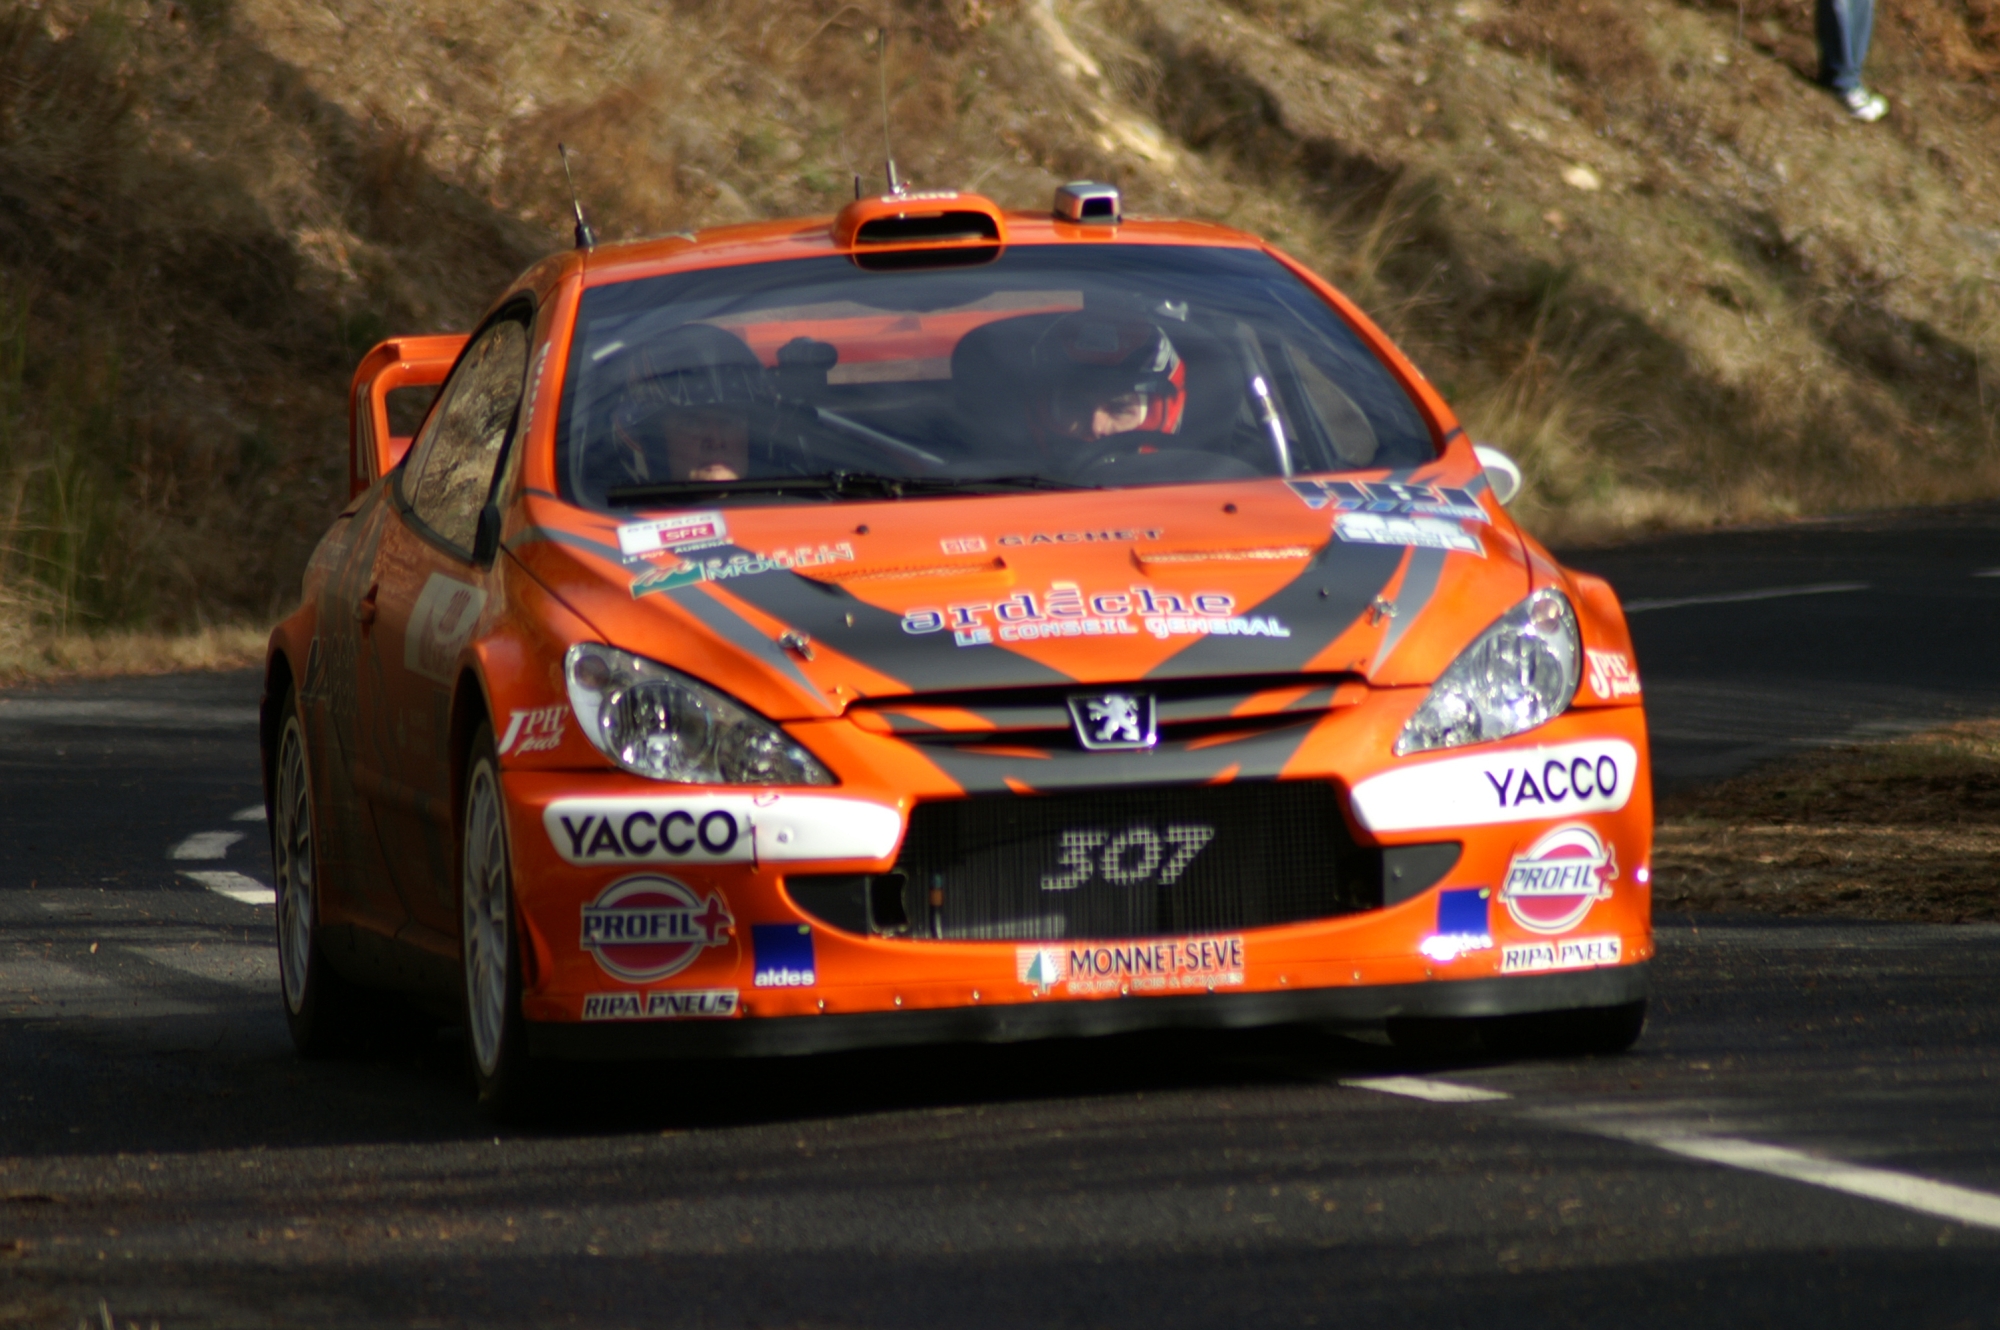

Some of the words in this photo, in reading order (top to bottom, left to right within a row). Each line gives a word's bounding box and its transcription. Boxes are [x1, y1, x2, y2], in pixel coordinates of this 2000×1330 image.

[665, 525, 710, 543] SFR
[997, 525, 1164, 547] GACHET
[955, 628, 994, 647] LE
[999, 617, 1139, 642] CONSEIL
[1483, 754, 1619, 808] YACCO
[560, 809, 739, 859] YACCO
[1040, 825, 1216, 890] 307
[1505, 947, 1555, 968] RIPA
[754, 968, 815, 986] aldes
[584, 995, 642, 1018] RIPA
[647, 993, 736, 1016] PNEUS
